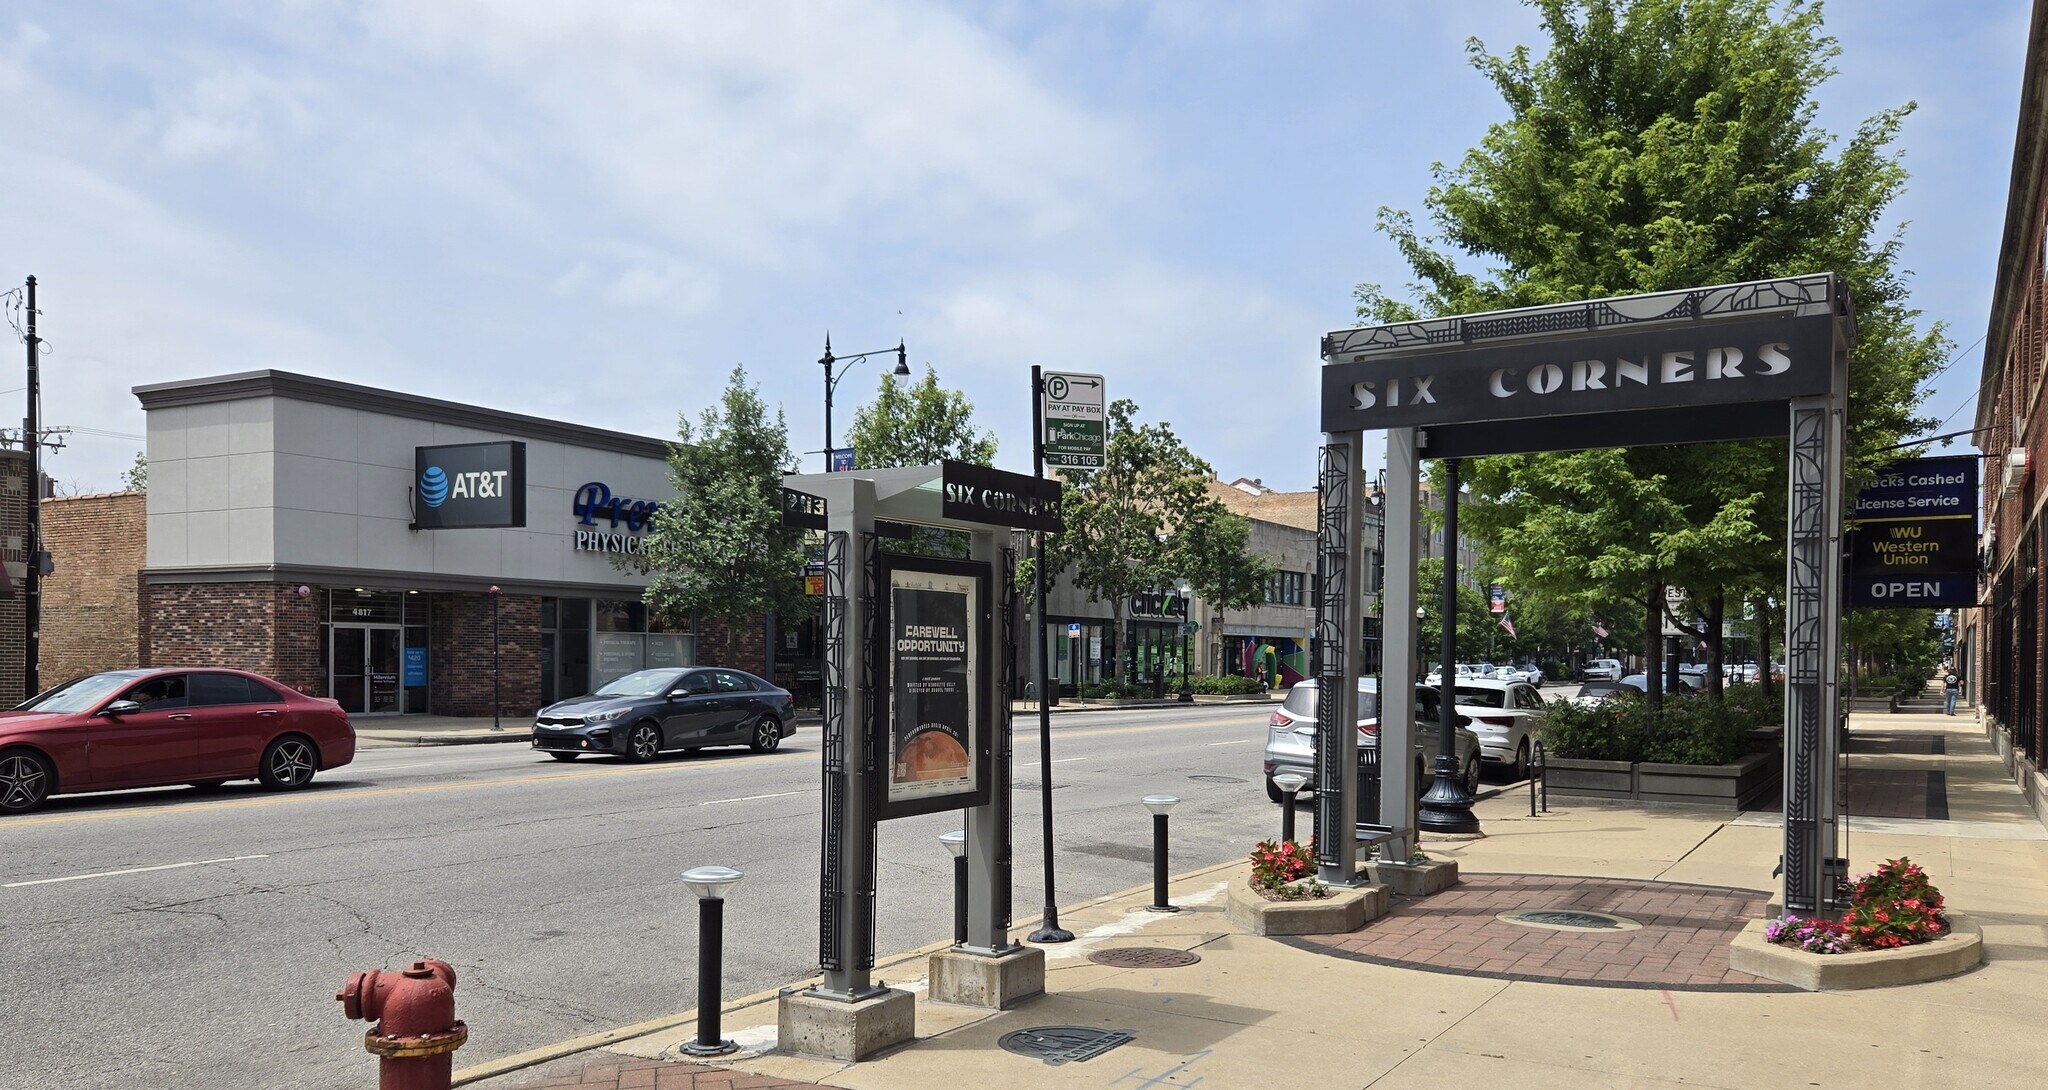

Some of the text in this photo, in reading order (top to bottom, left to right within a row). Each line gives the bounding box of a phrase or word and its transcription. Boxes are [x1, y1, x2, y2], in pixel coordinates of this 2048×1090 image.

[1350, 342, 1791, 411] SIX CORNERS
[1048, 404, 1061, 412] PAY
[1072, 405, 1085, 413] PAY
[1086, 406, 1101, 414] BOX
[1057, 431, 1101, 443] ParkChicago
[1061, 455, 1079, 464] 316
[1081, 456, 1098, 465] 105
[452, 470, 507, 499] AT&T
[1908, 472, 1965, 486] Cashed
[946, 483, 975, 505] SIX
[1855, 494, 1960, 510] License Service
[1893, 526, 1922, 538] WU
[1872, 541, 1939, 553] Western
[1884, 552, 1929, 565] Union
[1871, 582, 1940, 598] OPEN
[352, 608, 372, 617] 4817
[905, 625, 958, 639] FAREWELL
[897, 639, 965, 653] OPPORTUNITY
